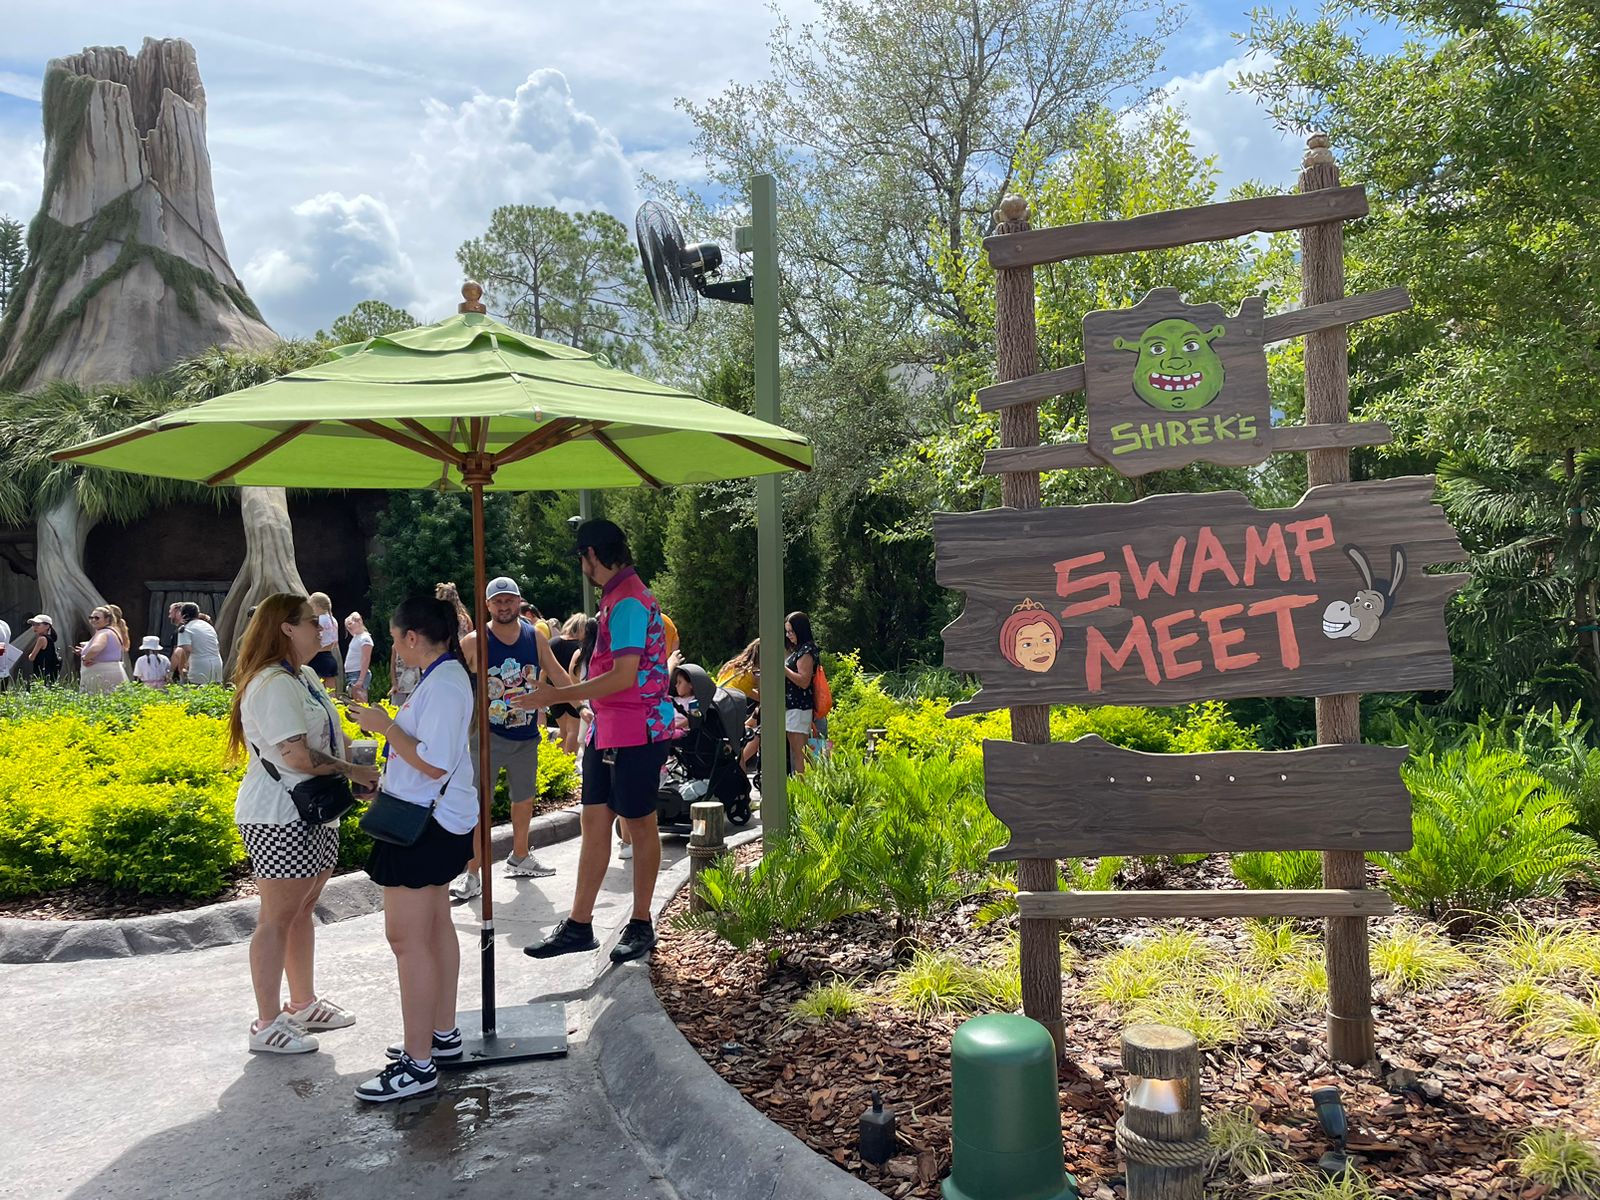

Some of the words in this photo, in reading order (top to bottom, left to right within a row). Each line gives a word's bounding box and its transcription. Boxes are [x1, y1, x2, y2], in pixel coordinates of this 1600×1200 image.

[1111, 413, 1257, 455] SHREK'S
[1054, 516, 1335, 617] SWAMP
[1086, 595, 1319, 692] MEET
